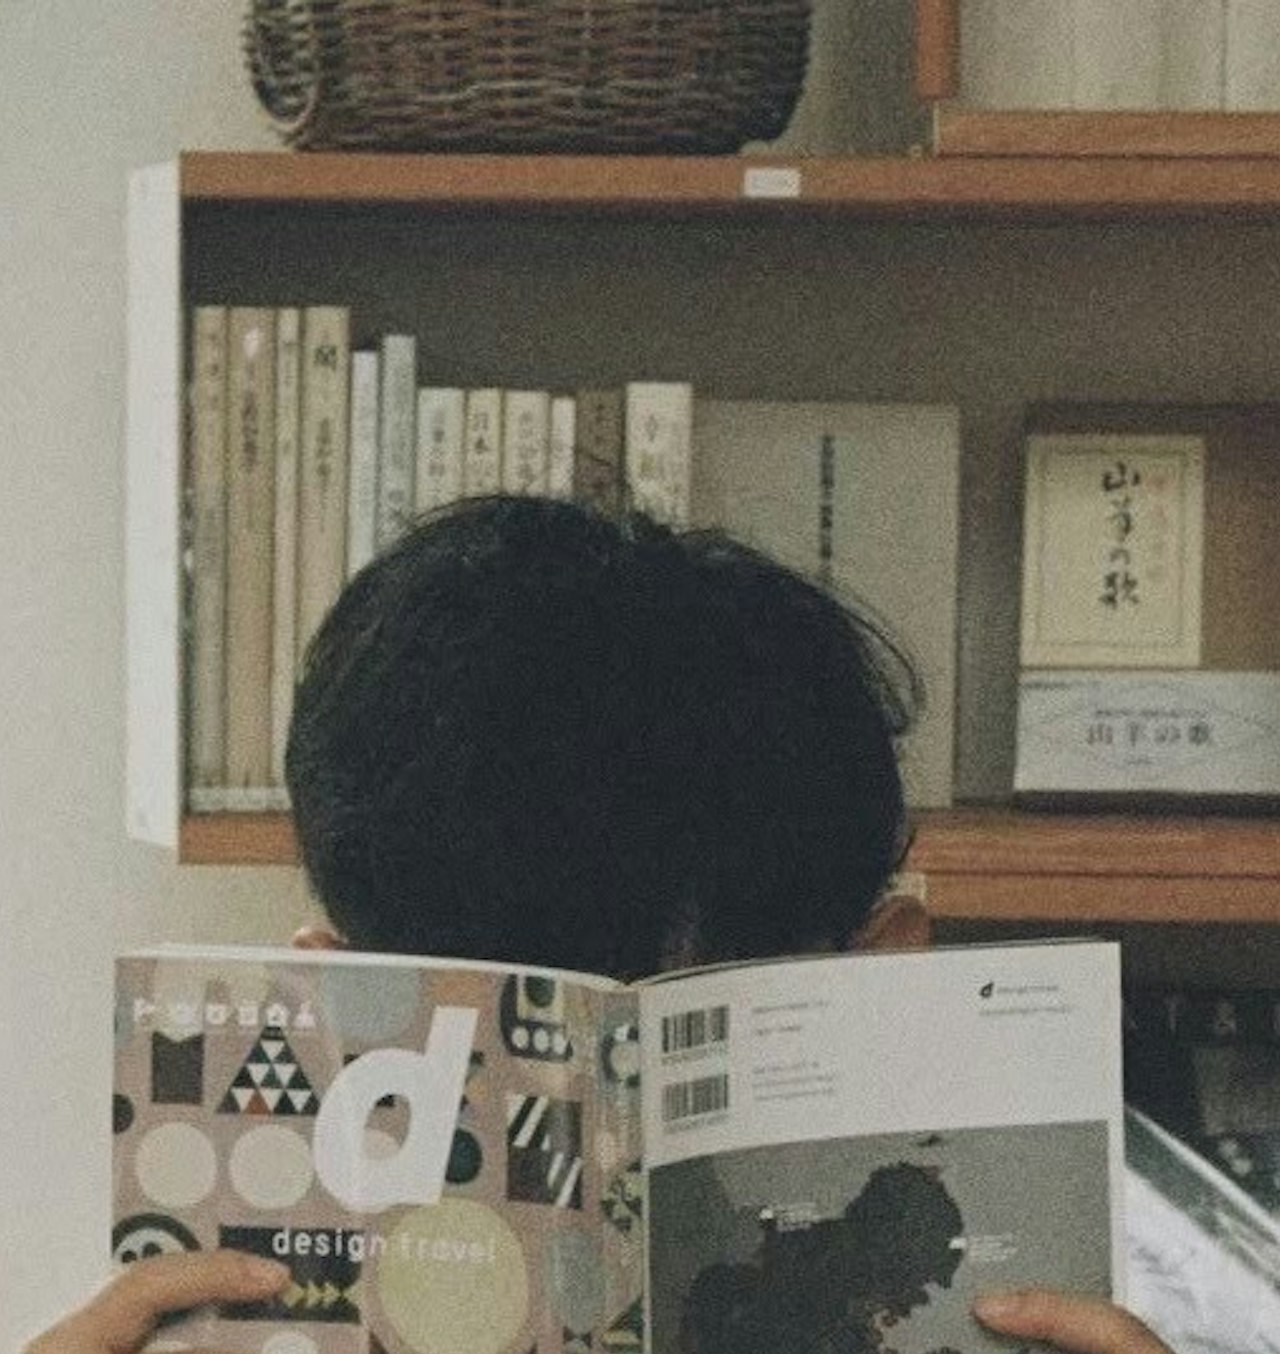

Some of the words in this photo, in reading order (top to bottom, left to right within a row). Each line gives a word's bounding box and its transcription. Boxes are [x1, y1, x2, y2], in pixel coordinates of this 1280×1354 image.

[313, 1006, 480, 1214] d
[272, 1228, 387, 1261] design
[400, 1229, 497, 1263] travel
